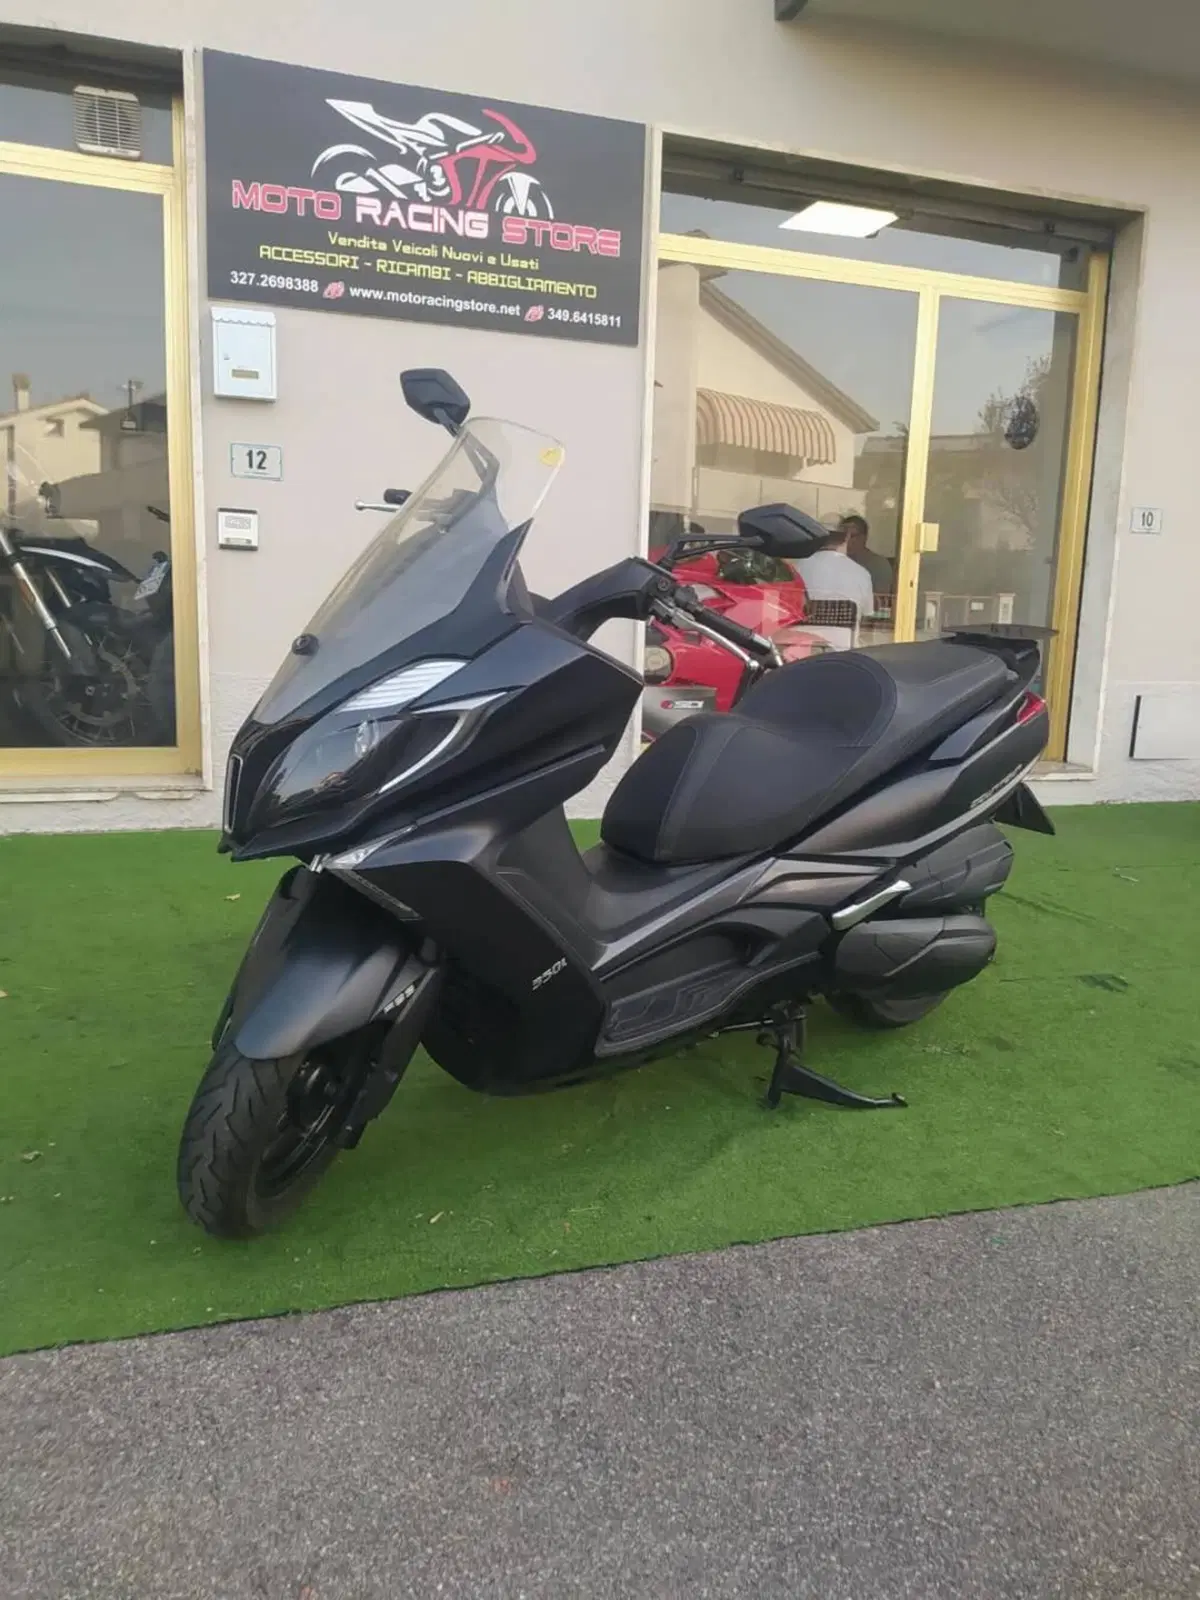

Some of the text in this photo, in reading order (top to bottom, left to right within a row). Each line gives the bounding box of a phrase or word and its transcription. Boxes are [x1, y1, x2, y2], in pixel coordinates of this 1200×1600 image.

[233, 180, 621, 257] MOTO RACING STORE
[259, 245, 360, 270] ACCESSORI
[376, 259, 452, 280] RICAMBI
[467, 270, 597, 299] ABBIGLIAMENTO
[328, 231, 539, 271] Vendita Veicoli Nuovi e Usati
[230, 271, 621, 328] 327.2698388 www.motoracingstore.net 349.6415811
[245, 449, 267, 470] 12
[1141, 511, 1154, 527] 10
